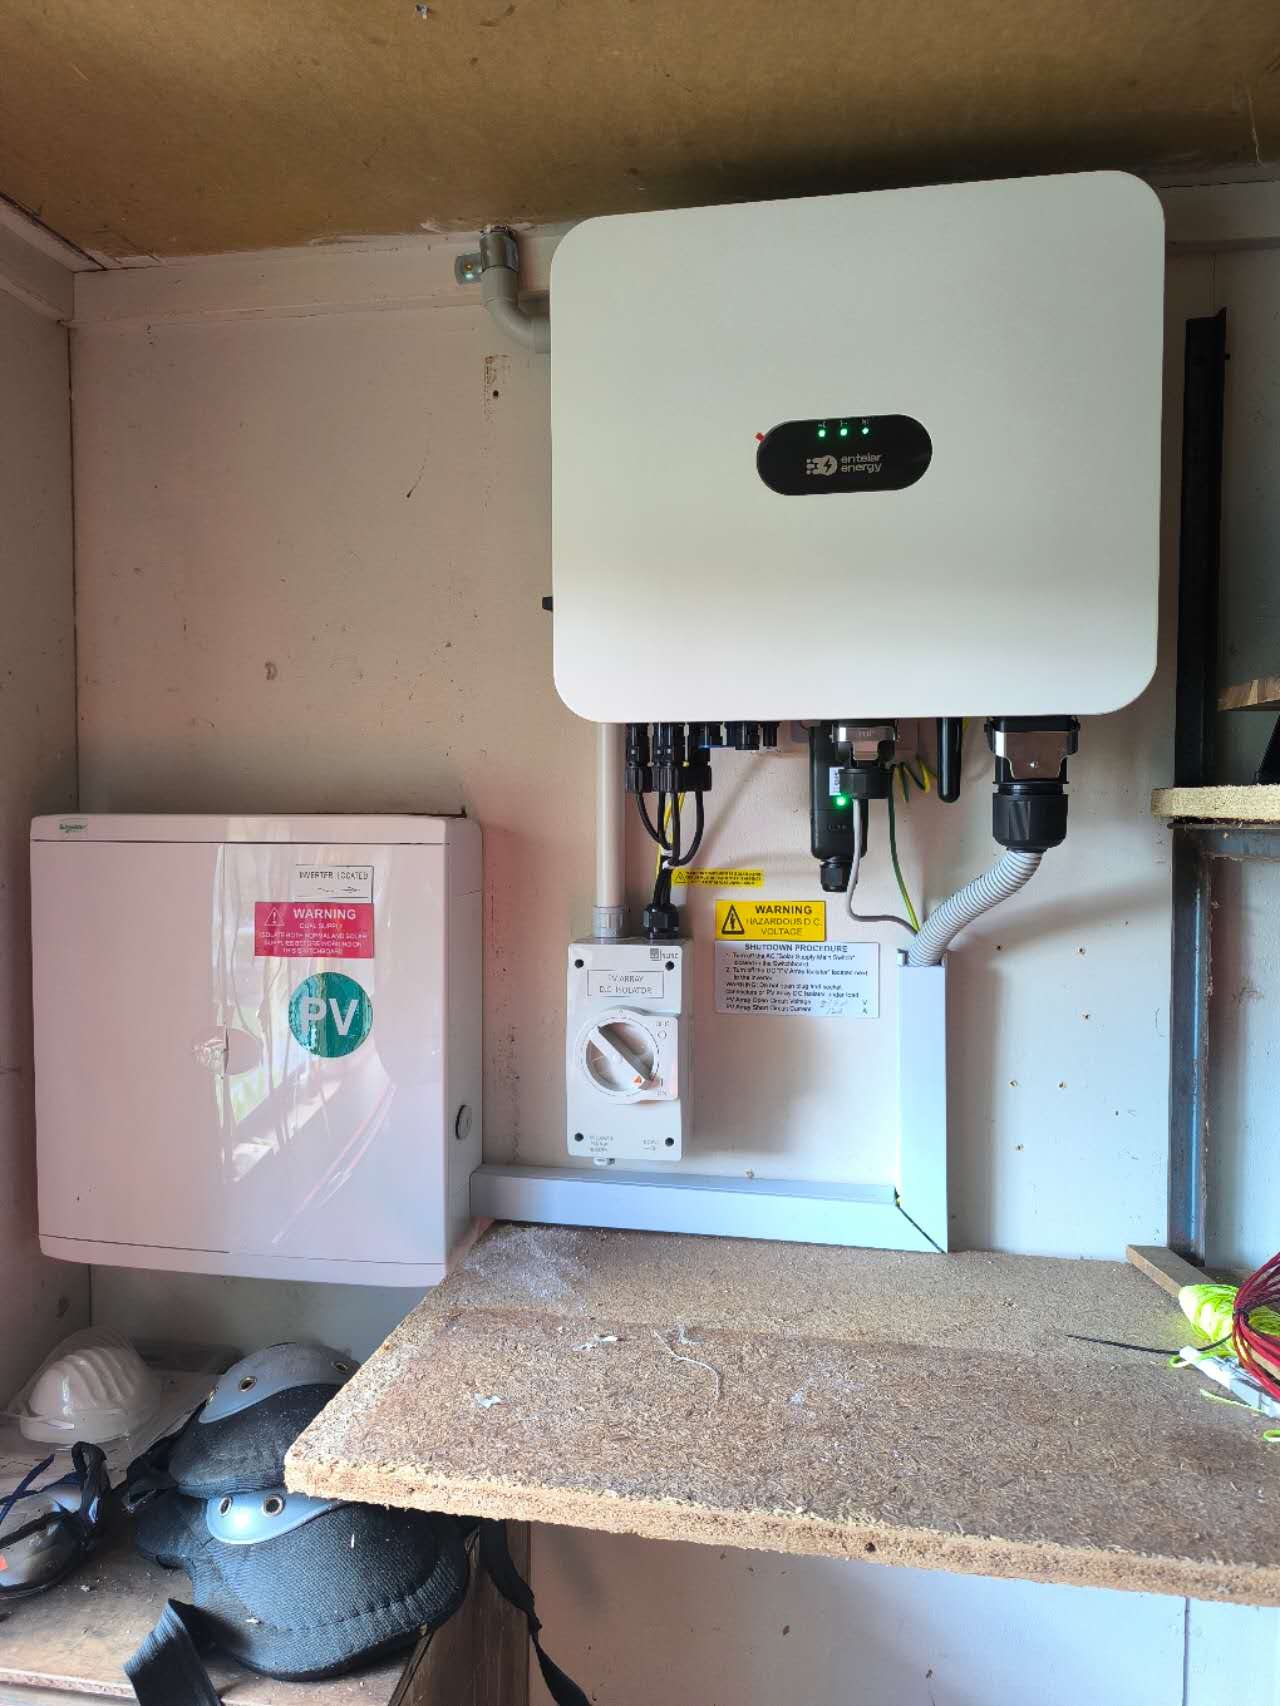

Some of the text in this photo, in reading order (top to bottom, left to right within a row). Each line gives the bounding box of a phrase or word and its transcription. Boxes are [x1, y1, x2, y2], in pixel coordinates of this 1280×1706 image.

[841, 452, 882, 464] entelar
[841, 462, 882, 474] energy
[336, 872, 368, 880] LOCATED
[293, 908, 356, 920] WARNING
[755, 905, 812, 914] WARNING
[746, 918, 802, 926] HAZARDOUS
[761, 928, 802, 936] VOLTAGE
[795, 944, 848, 952] PROCEDURE
[301, 995, 359, 1036] PV
